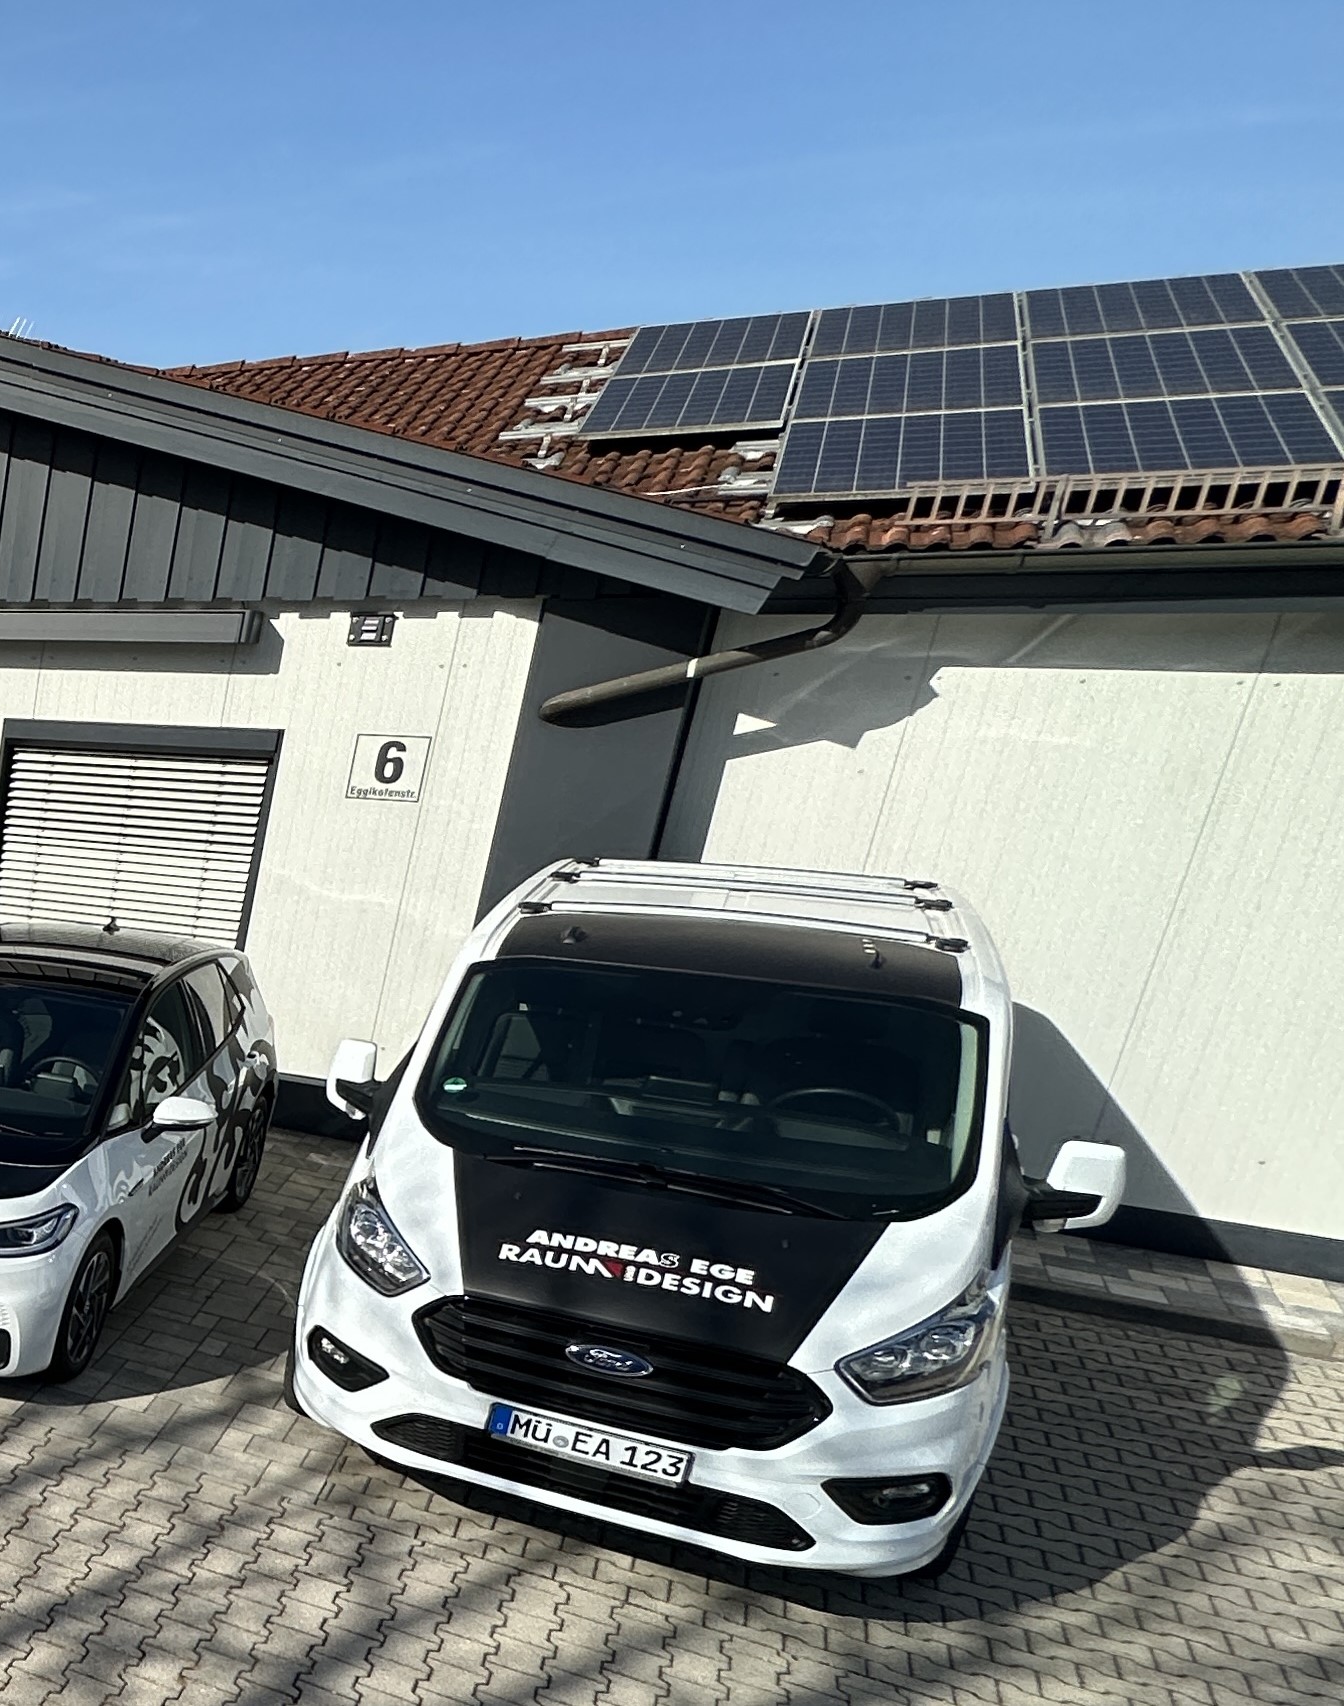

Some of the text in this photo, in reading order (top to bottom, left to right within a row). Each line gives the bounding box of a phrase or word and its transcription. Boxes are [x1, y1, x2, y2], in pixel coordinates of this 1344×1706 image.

[374, 740, 407, 785] 6
[498, 1243, 615, 1279] RAUM
[636, 1266, 775, 1314] DESIGN
[526, 1229, 756, 1286] ANDREAS EGE
[509, 1413, 553, 1444] MÜ
[570, 1431, 611, 1461] EA
[619, 1445, 685, 1478] 123
